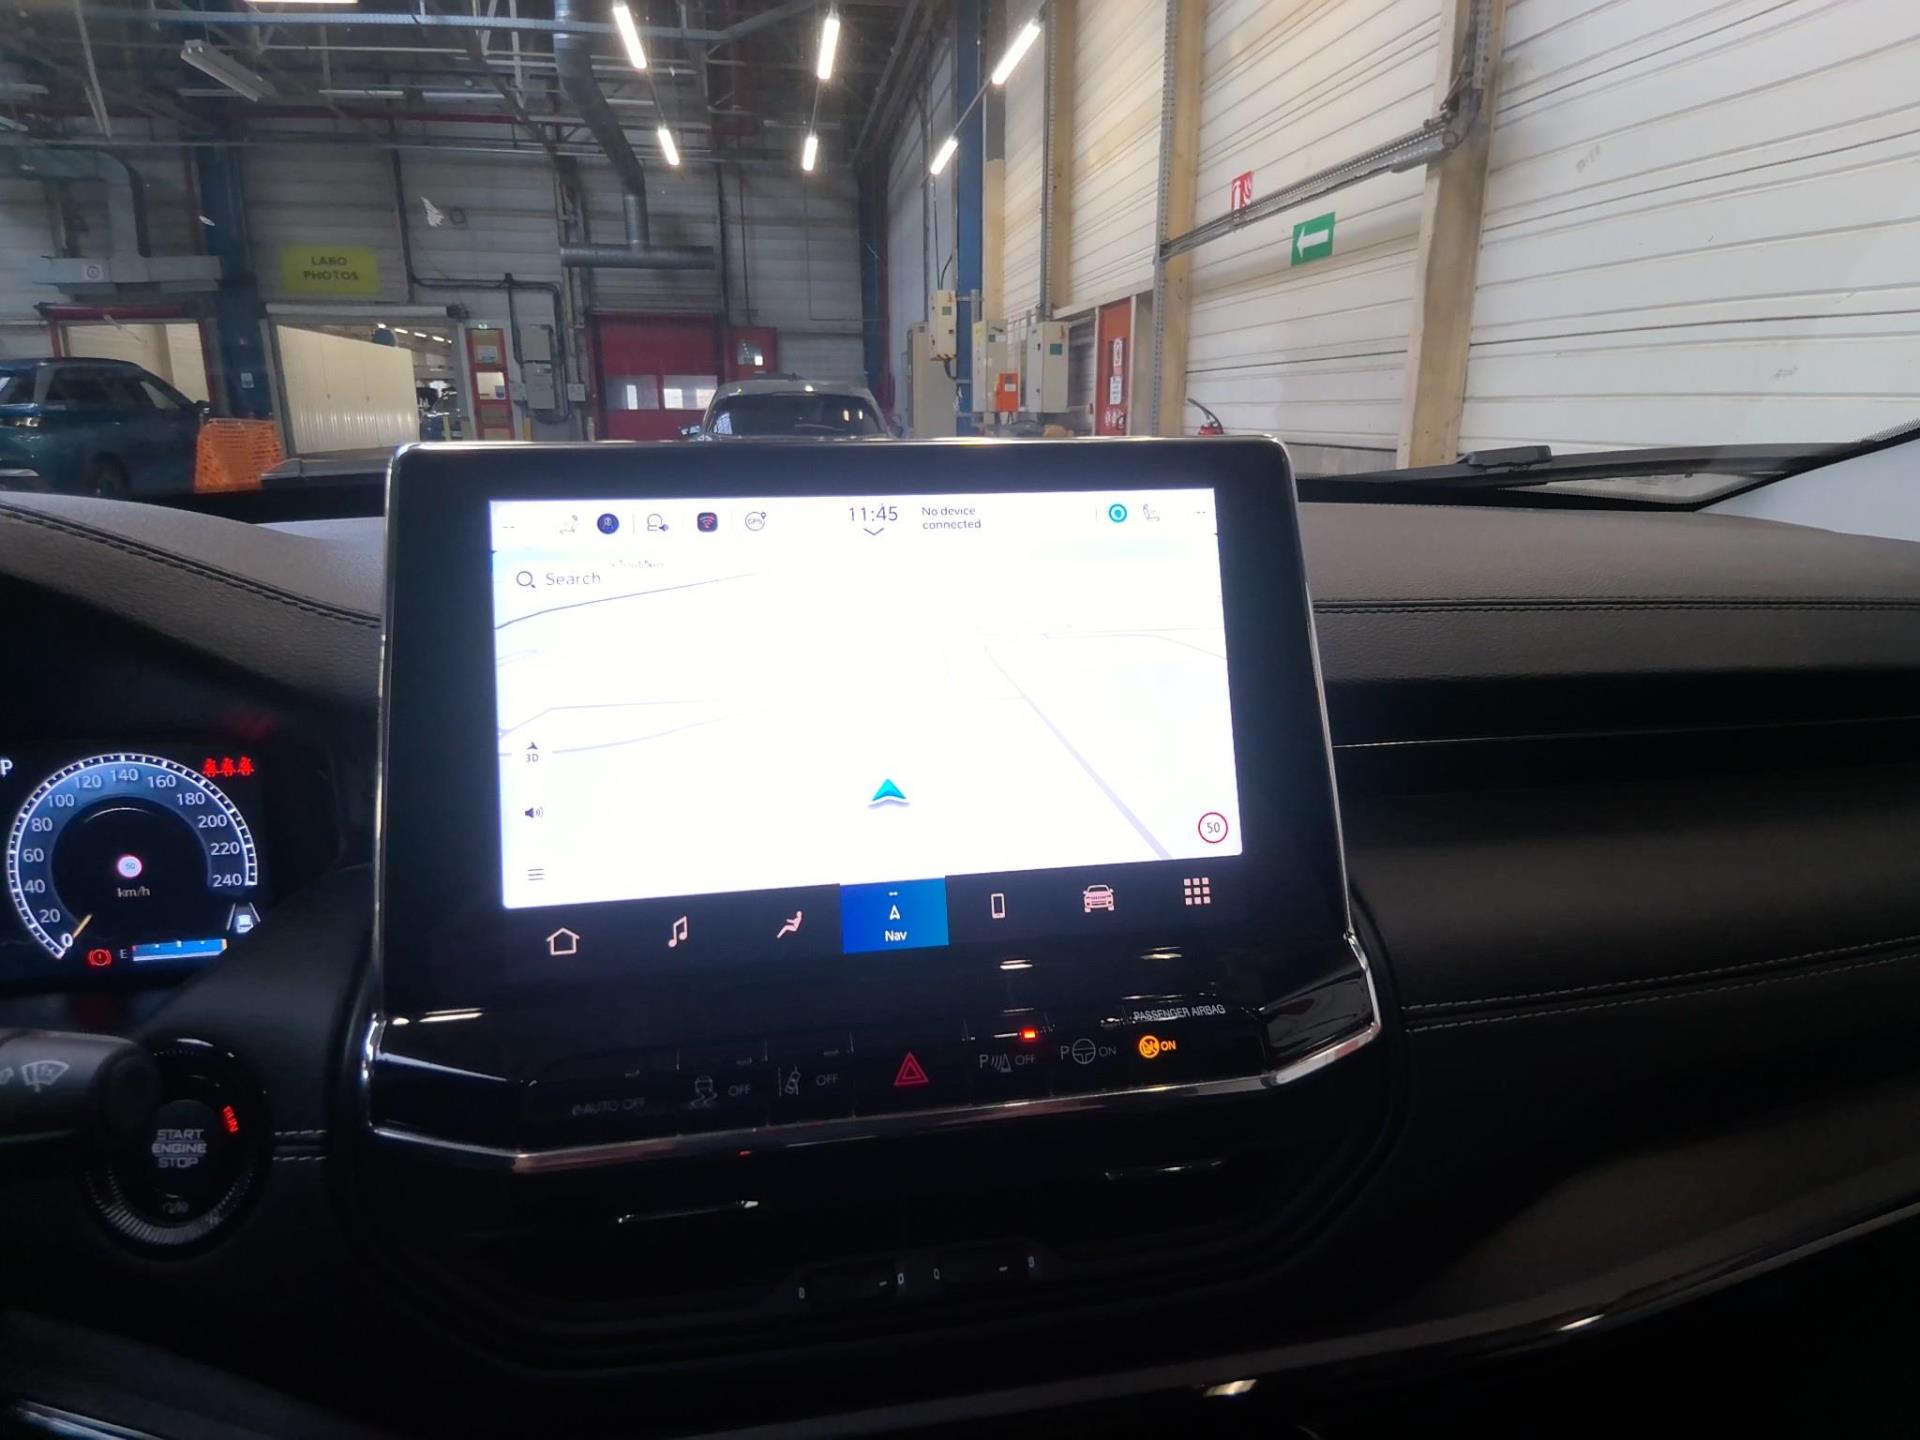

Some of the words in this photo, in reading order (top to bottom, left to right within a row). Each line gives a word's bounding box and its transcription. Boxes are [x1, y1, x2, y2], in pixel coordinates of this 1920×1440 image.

[311, 256, 348, 266] LABO
[303, 270, 360, 281] PHOTOS
[849, 506, 898, 521] 11:45
[921, 507, 938, 516] No
[940, 506, 975, 516] device
[922, 519, 982, 530] connected
[545, 571, 601, 587] Search
[75, 775, 102, 790] 120
[110, 768, 139, 783] 140
[148, 775, 177, 790] 160
[47, 794, 75, 808] 100
[177, 792, 206, 807] 180
[31, 817, 53, 833] 80
[198, 815, 228, 829] 200
[1206, 821, 1221, 834] 50
[23, 848, 45, 863] 60
[210, 842, 240, 856] 220
[24, 879, 46, 894] 40
[212, 874, 242, 888] 240
[117, 886, 151, 898] km/h
[40, 908, 61, 923] 20
[61, 934, 73, 948] 0
[885, 929, 907, 943] Nav
[120, 949, 128, 960] E
[1133, 1008, 1190, 1022] PASSENGER
[1191, 1003, 1226, 1015] AIRBAG
[1099, 1045, 1117, 1057] ON
[1160, 1039, 1177, 1052] ON
[1016, 1055, 1036, 1065] OFF
[816, 1074, 838, 1086] OFF
[729, 1084, 750, 1097] OFF
[156, 1128, 205, 1141] START
[151, 1142, 207, 1154] ENGINE
[157, 1156, 199, 1168] STOP
